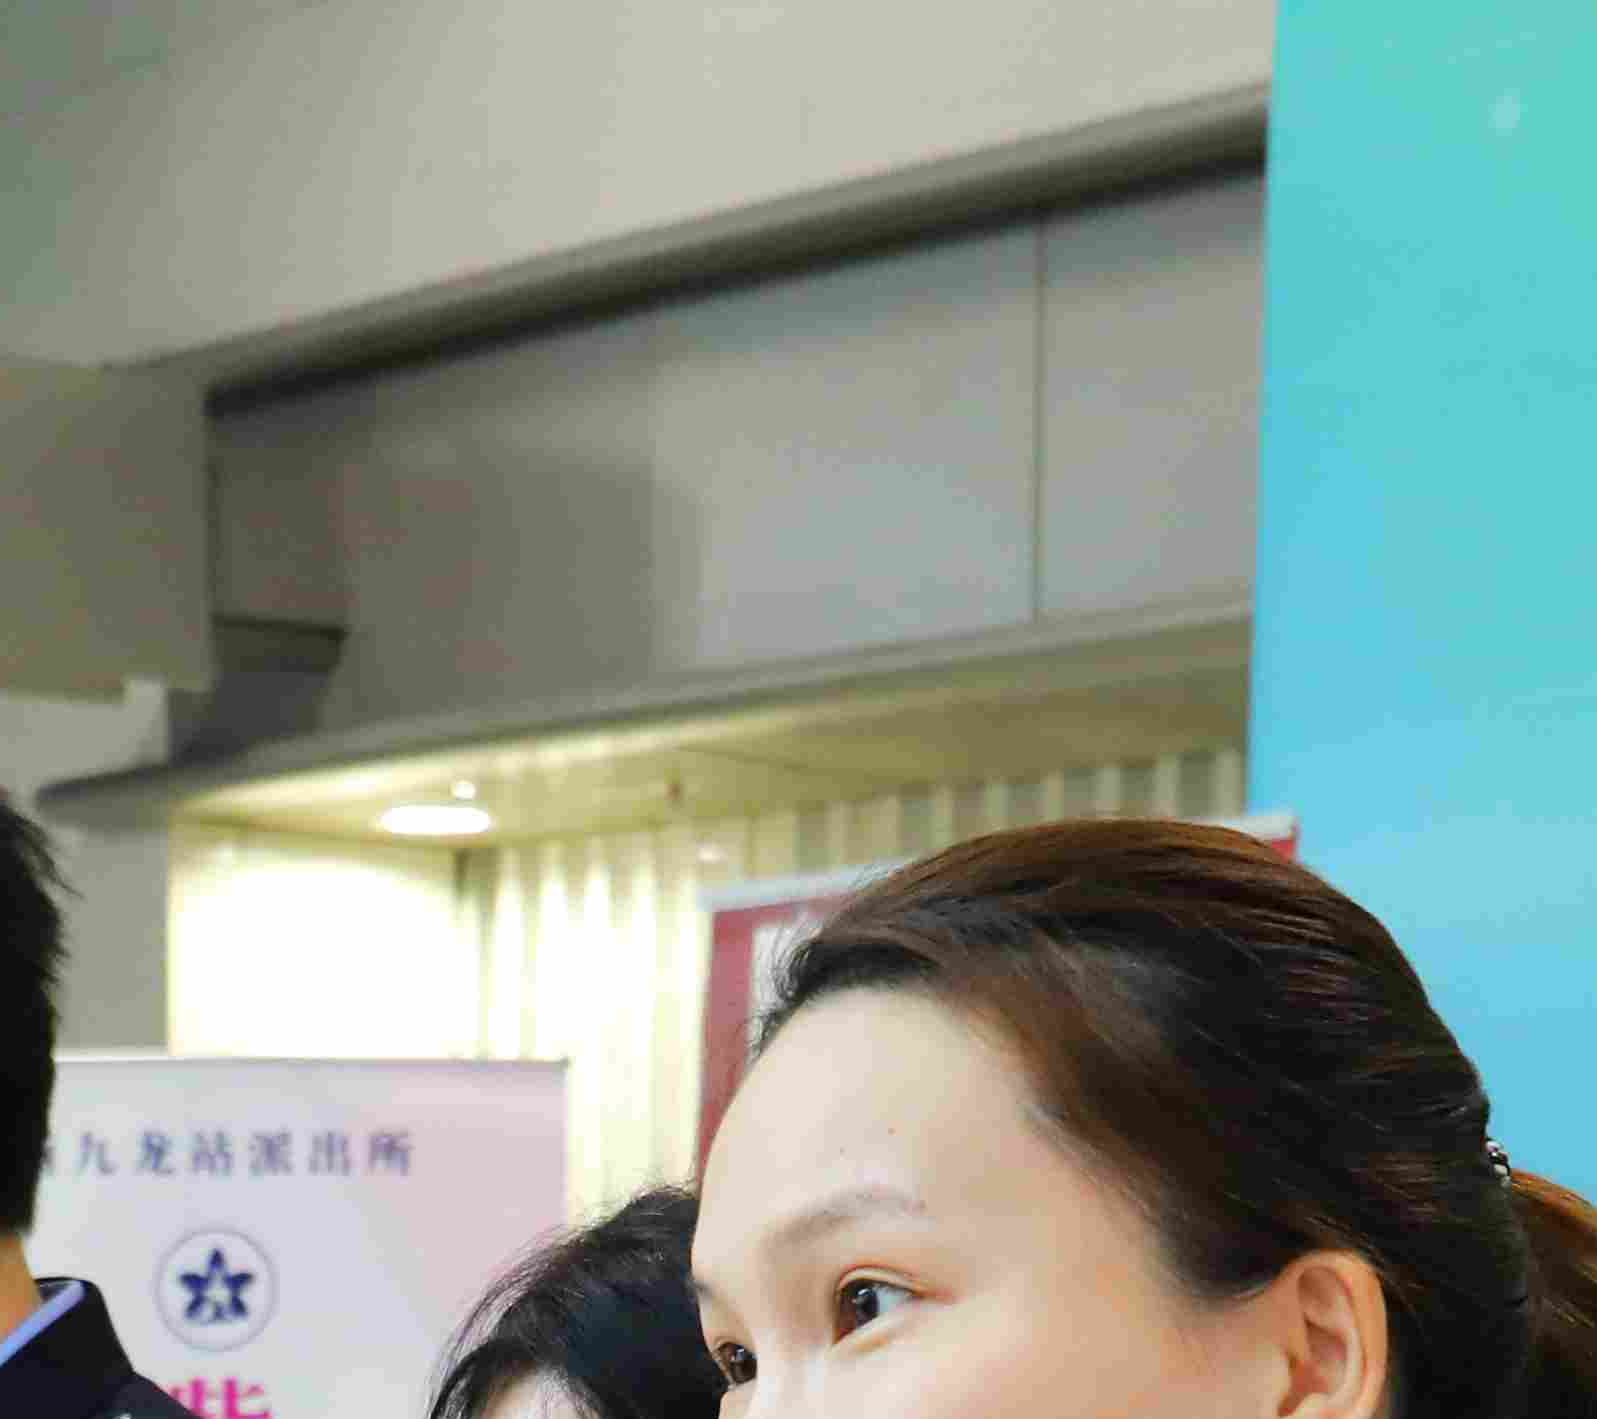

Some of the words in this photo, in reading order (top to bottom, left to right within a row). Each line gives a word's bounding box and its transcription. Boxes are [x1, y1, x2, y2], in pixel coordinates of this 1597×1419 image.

[44, 1126, 414, 1176] 九龙站派出所
